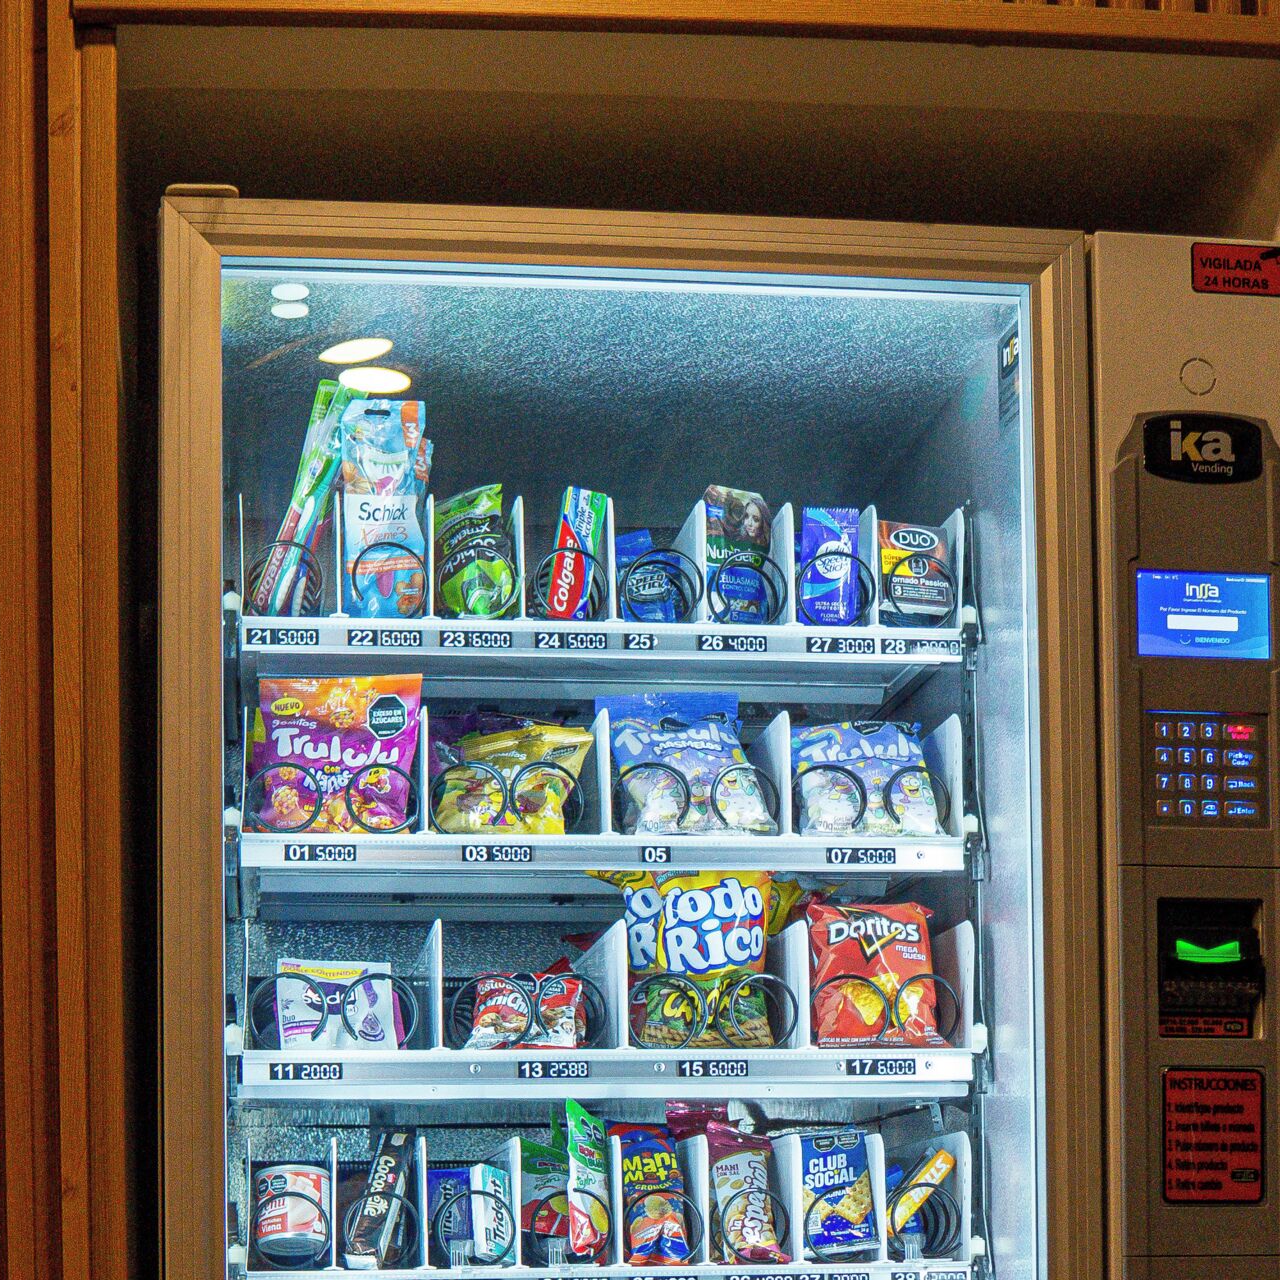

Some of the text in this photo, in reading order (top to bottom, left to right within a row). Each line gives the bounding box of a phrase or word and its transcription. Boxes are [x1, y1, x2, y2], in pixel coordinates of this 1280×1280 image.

[1200, 257, 1262, 272] VIGILADA
[1204, 276, 1269, 290] 24 HORAS
[1170, 420, 1235, 462] ika
[1192, 462, 1233, 476] Vending
[358, 502, 408, 522] Schick
[576, 506, 587, 533] Triple
[899, 533, 932, 547] DUO
[554, 538, 577, 611] Colgate
[628, 573, 665, 586] SPEED
[634, 582, 666, 594] STICK
[250, 629, 270, 644] 21
[350, 630, 374, 646] 22
[443, 632, 465, 647] 23
[538, 634, 560, 648] 24
[628, 634, 650, 649] 25
[702, 636, 724, 650] 26
[810, 638, 832, 652] 27
[884, 640, 906, 654] 28
[274, 702, 300, 712] NUEVO
[272, 719, 317, 730] gomitas
[1183, 727, 1190, 737] 2
[1205, 727, 1212, 737] 3
[272, 727, 399, 767] Trululu
[1184, 752, 1190, 762] 5
[1206, 753, 1213, 763] 6
[1161, 778, 1168, 788] 7
[1184, 779, 1191, 788] 8
[1206, 779, 1213, 789] 9
[1184, 804, 1191, 814] 0
[288, 846, 310, 860] 01
[465, 846, 488, 862] 03
[644, 848, 666, 862] 05
[830, 849, 852, 864] 07
[828, 917, 920, 945] Doritos
[665, 918, 763, 972] Rico
[895, 945, 918, 954] MEGA
[903, 952, 927, 962] QUESO
[274, 1064, 294, 1079] 11
[520, 1062, 542, 1078] 13
[682, 1062, 703, 1076] 15
[852, 1060, 873, 1074] 17
[1169, 1077, 1257, 1092] INSTRUCCIONES
[623, 1151, 679, 1172] Mani
[809, 1153, 848, 1174] CLUB
[491, 1177, 505, 1242] Trident
[261, 1223, 282, 1234] Viena
